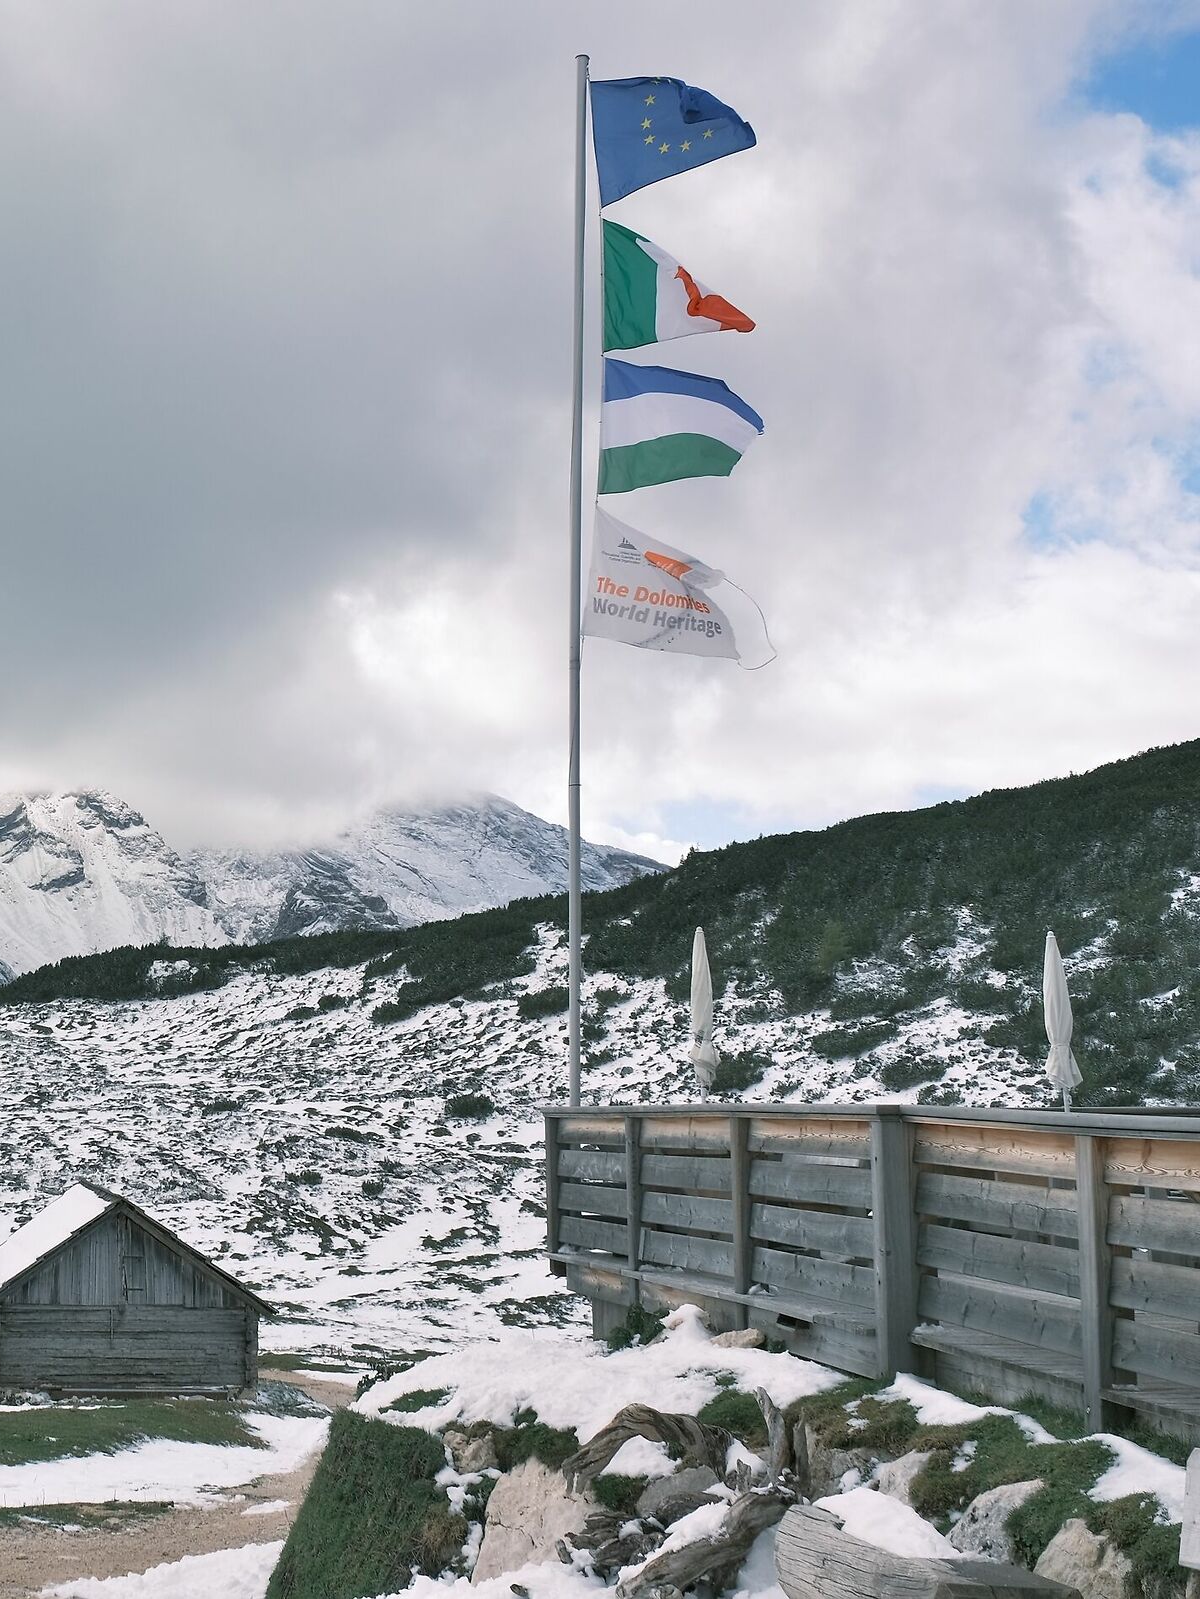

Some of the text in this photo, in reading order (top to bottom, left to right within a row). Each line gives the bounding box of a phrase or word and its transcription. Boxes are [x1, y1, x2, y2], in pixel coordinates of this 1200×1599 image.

[597, 576, 629, 597] The
[593, 597, 722, 637] World Heritage
